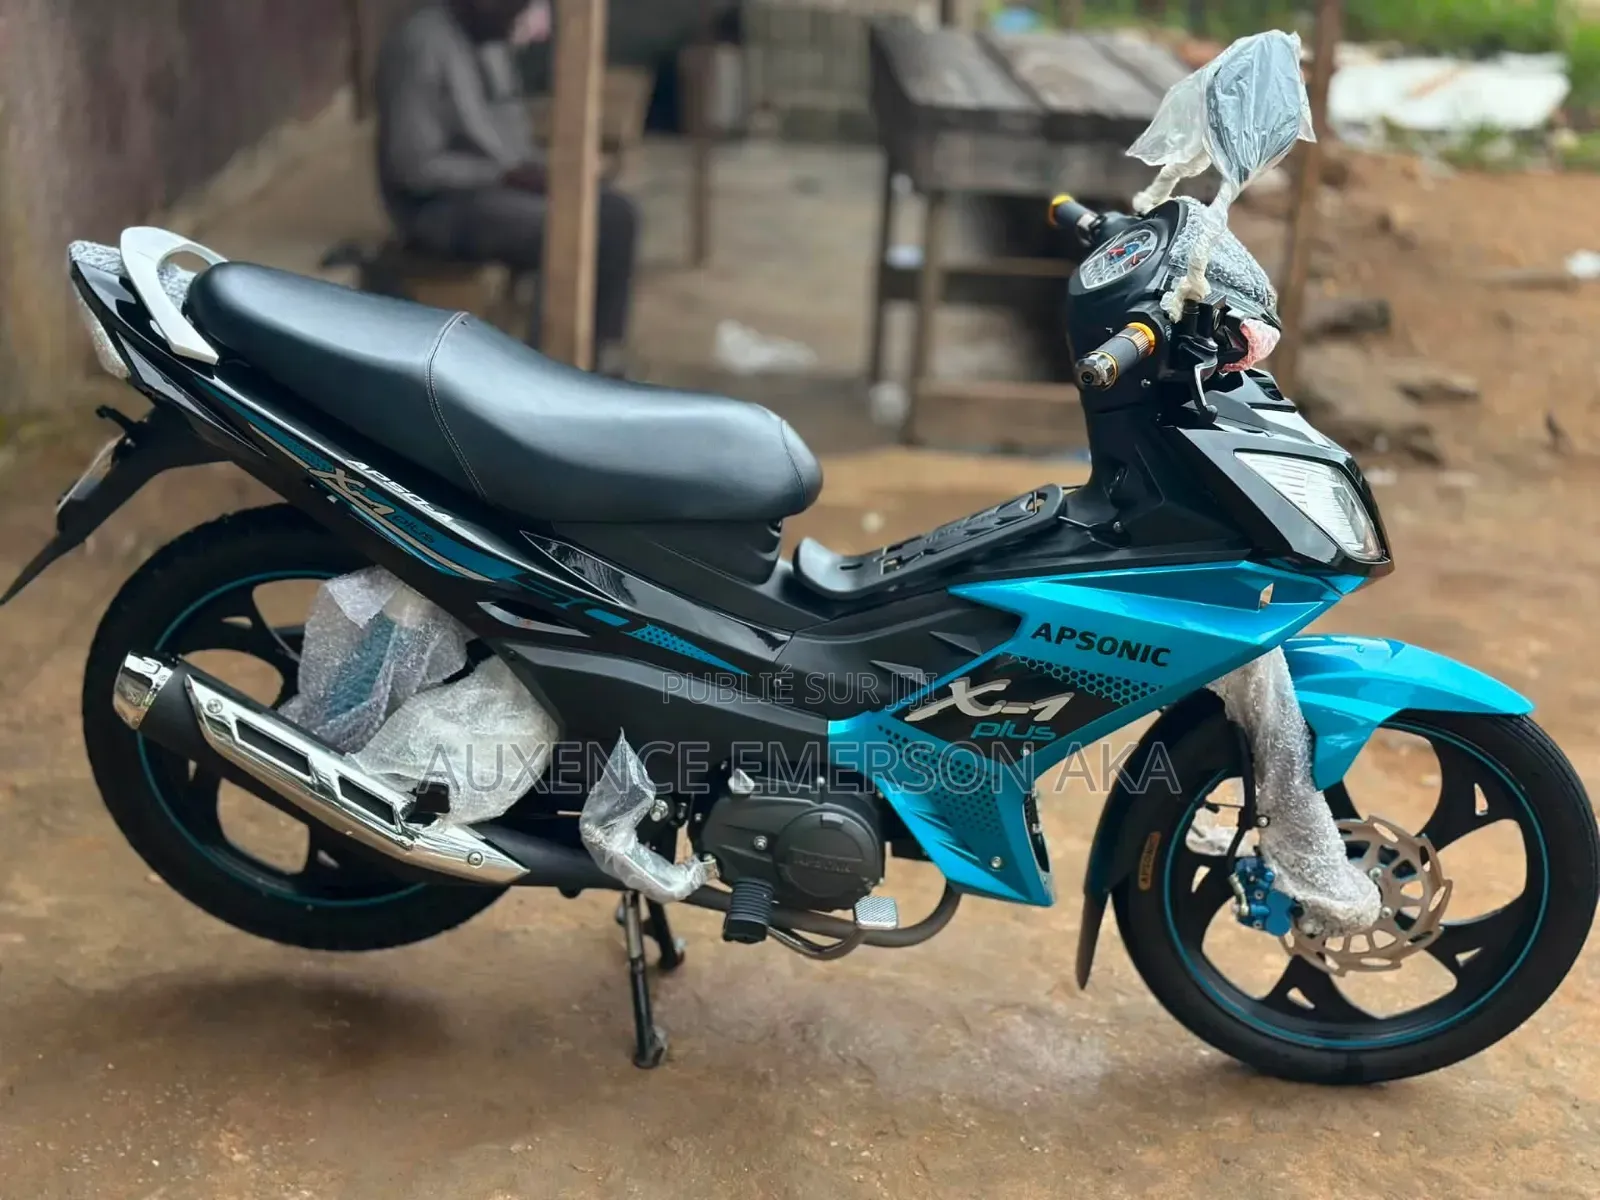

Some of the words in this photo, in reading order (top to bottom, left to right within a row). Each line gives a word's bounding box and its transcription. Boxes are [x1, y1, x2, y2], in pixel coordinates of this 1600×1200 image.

[1031, 622, 1172, 667] APSONIC
[904, 677, 1075, 722] X-1
[970, 720, 1057, 741] plus
